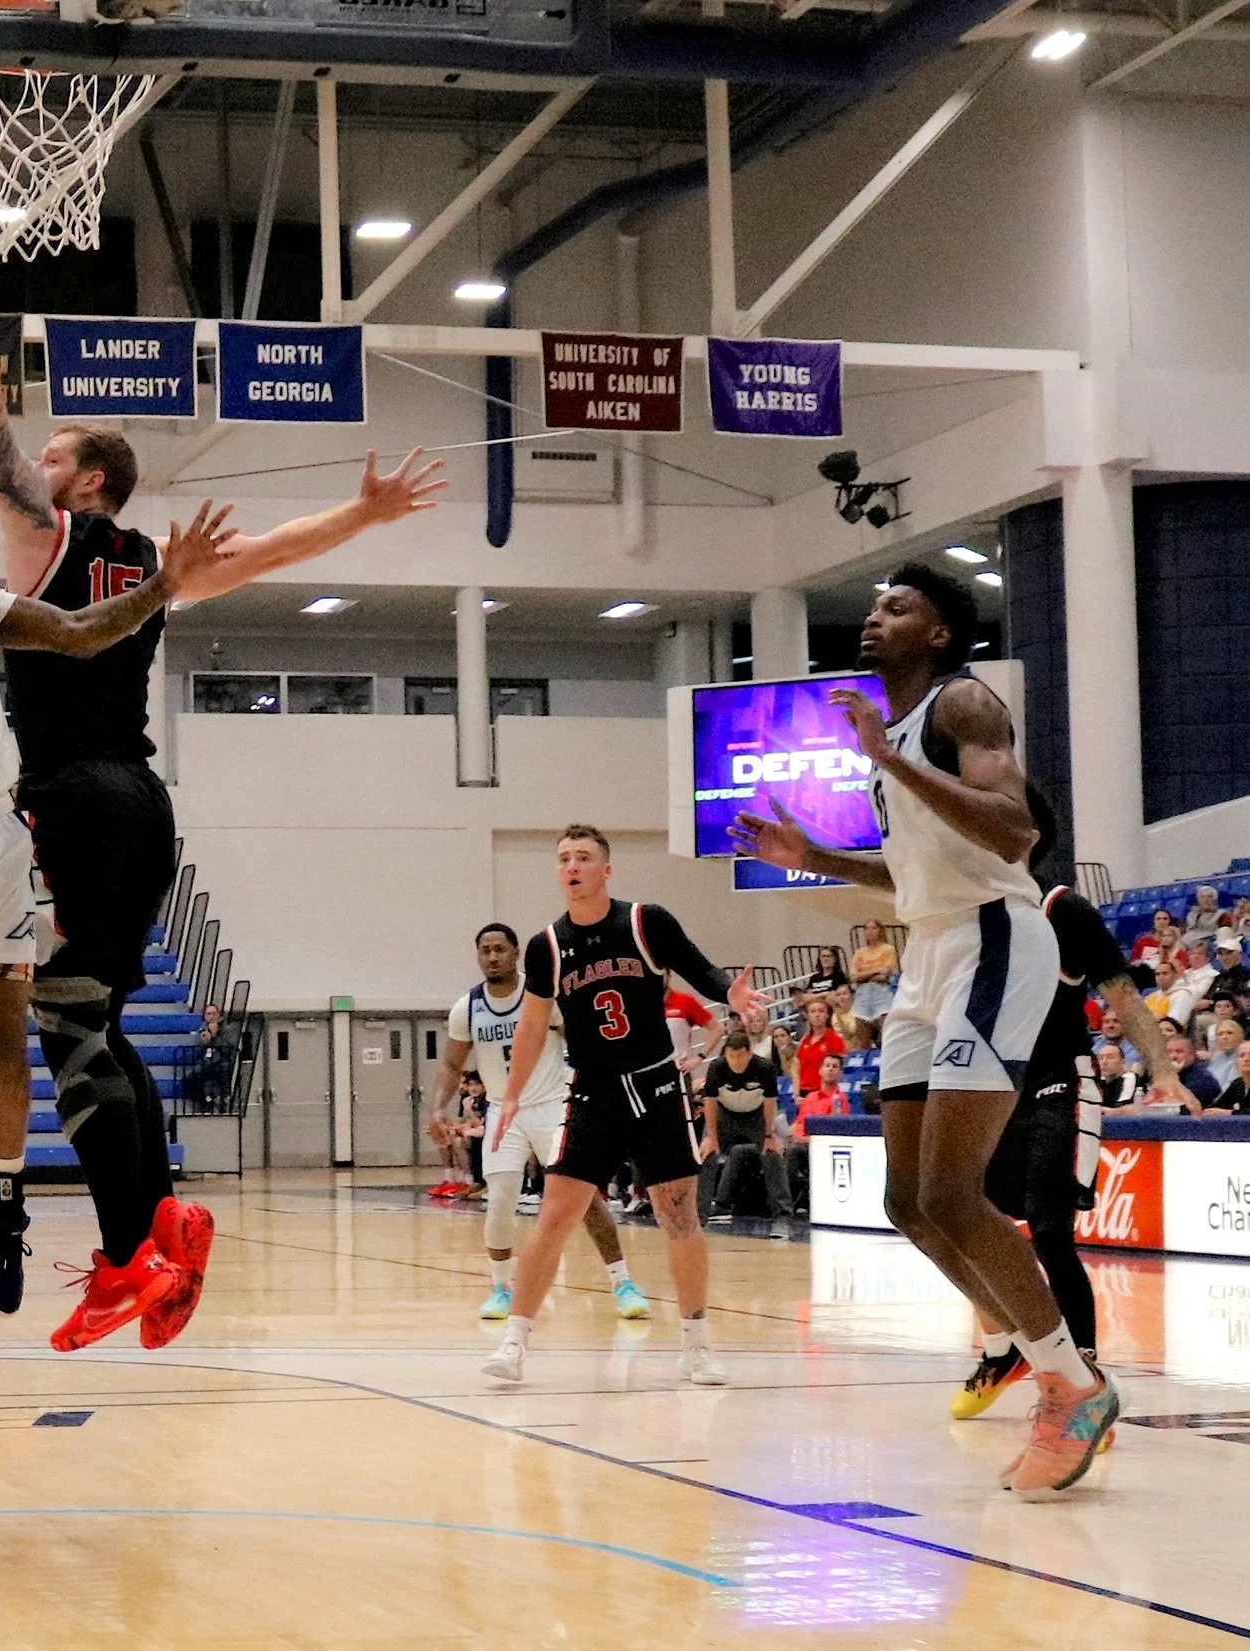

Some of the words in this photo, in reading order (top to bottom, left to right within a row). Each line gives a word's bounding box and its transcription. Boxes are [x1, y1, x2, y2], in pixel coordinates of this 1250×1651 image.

[80, 338, 161, 360] LANDER
[257, 343, 323, 366] NORTH
[554, 342, 639, 366] UNIVERSITY
[653, 347, 671, 368] OF
[549, 371, 595, 392] SOUTH
[607, 374, 676, 395] CAROLINA
[739, 363, 811, 386] YOUNG
[62, 376, 182, 398] UNIVERSITY
[248, 381, 333, 403] GEORGIA
[586, 401, 641, 422] AIKEN
[735, 390, 818, 413] HARRIS
[732, 747, 873, 785] DEFEN
[561, 957, 645, 996] FLAGLER
[593, 989, 631, 1041] 3
[477, 1021, 518, 1044] AUGU
